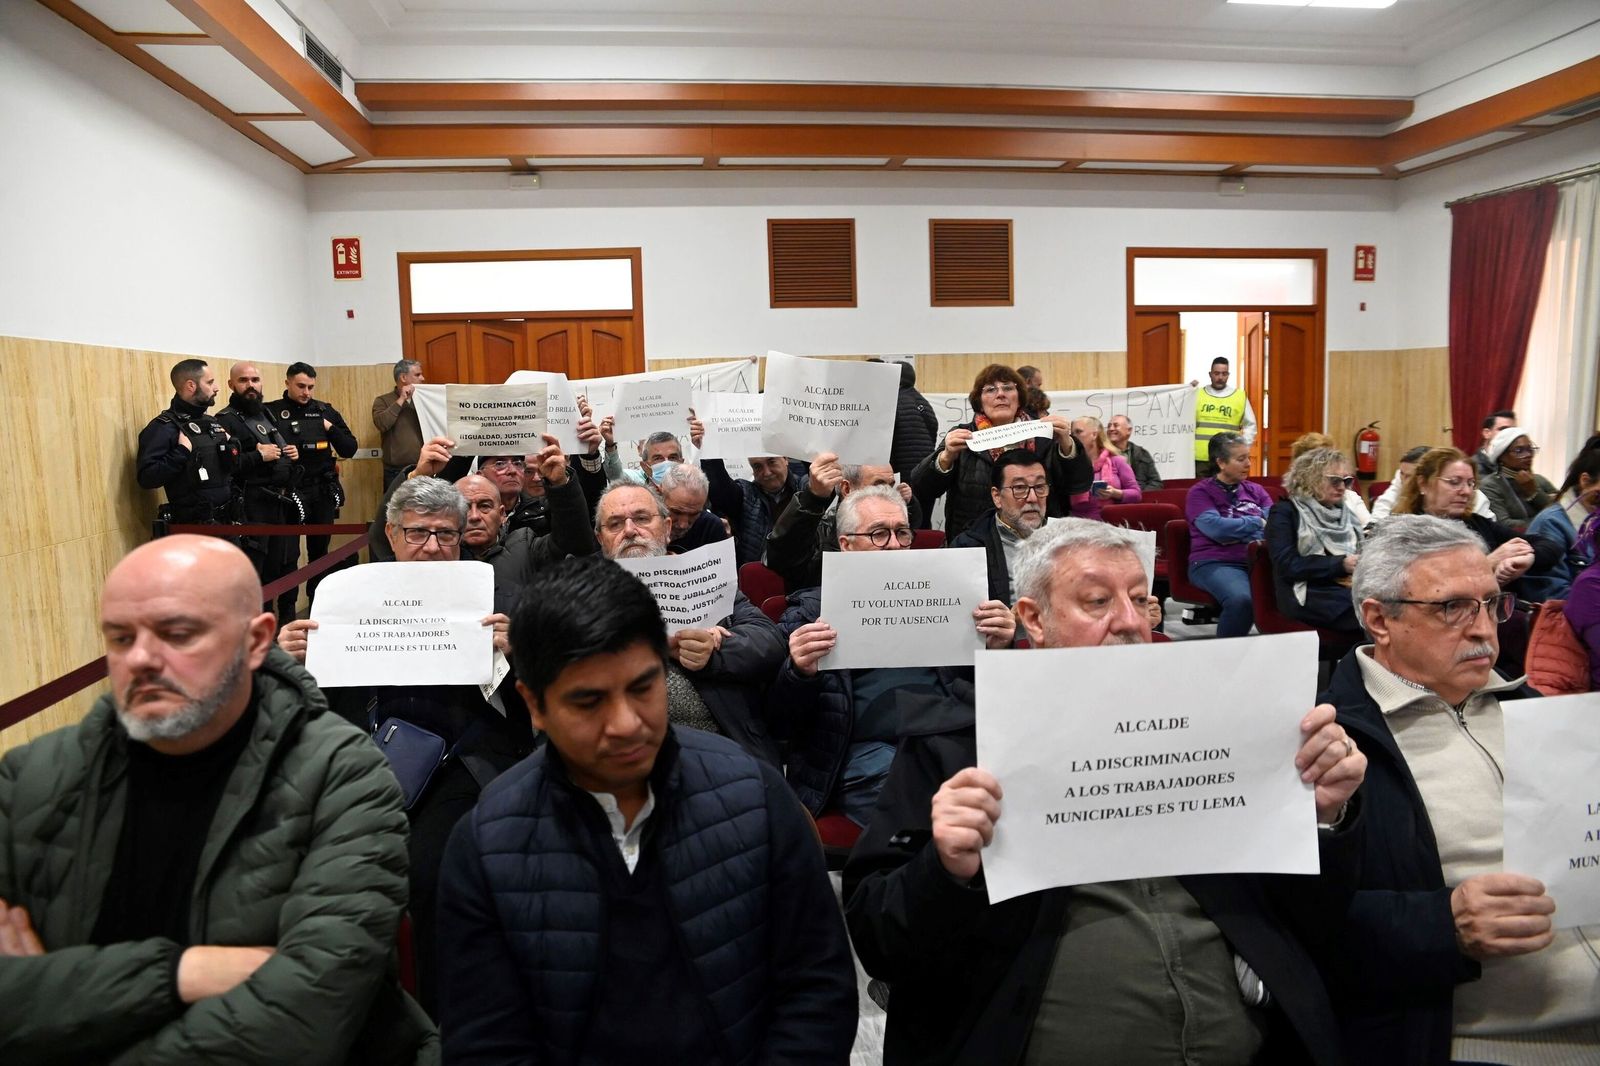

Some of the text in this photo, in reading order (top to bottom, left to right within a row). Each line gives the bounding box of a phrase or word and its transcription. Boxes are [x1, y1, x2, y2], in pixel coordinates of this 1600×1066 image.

[804, 385, 844, 396] ALCALDE
[473, 400, 536, 409] DICRIMINACIÓN
[782, 397, 870, 411] TU VOLUNTAD BRILLA
[788, 413, 859, 427] POR TU AUSENCIA
[1134, 424, 1158, 436] RES
[1152, 452, 1176, 464] GUE
[653, 558, 722, 576] DISCRIMINACIÓN!
[647, 573, 717, 589] RETROACTIVIDAD
[883, 581, 931, 590] ALCALDE
[682, 582, 728, 601] JUBILACIÓN
[660, 605, 690, 613] ALDAD,
[851, 598, 961, 608] TU VOLUNTAD BRILLA
[372, 617, 447, 625] DISCRIMINACION
[861, 615, 950, 626] POR TU AUSENCIA
[363, 631, 381, 639] LOS
[382, 630, 450, 638] TRABAJADORES
[345, 643, 457, 652] MUNICIPALES ES TU LEMA
[1114, 717, 1190, 734] ALCALDE
[1071, 747, 1231, 773] LA DISCRIMINACION
[1064, 771, 1235, 798] A LOS TRABAJADORES
[1045, 795, 1247, 825] MUNICIPALES ES TU LEMA
[1584, 830, 1594, 843] A
